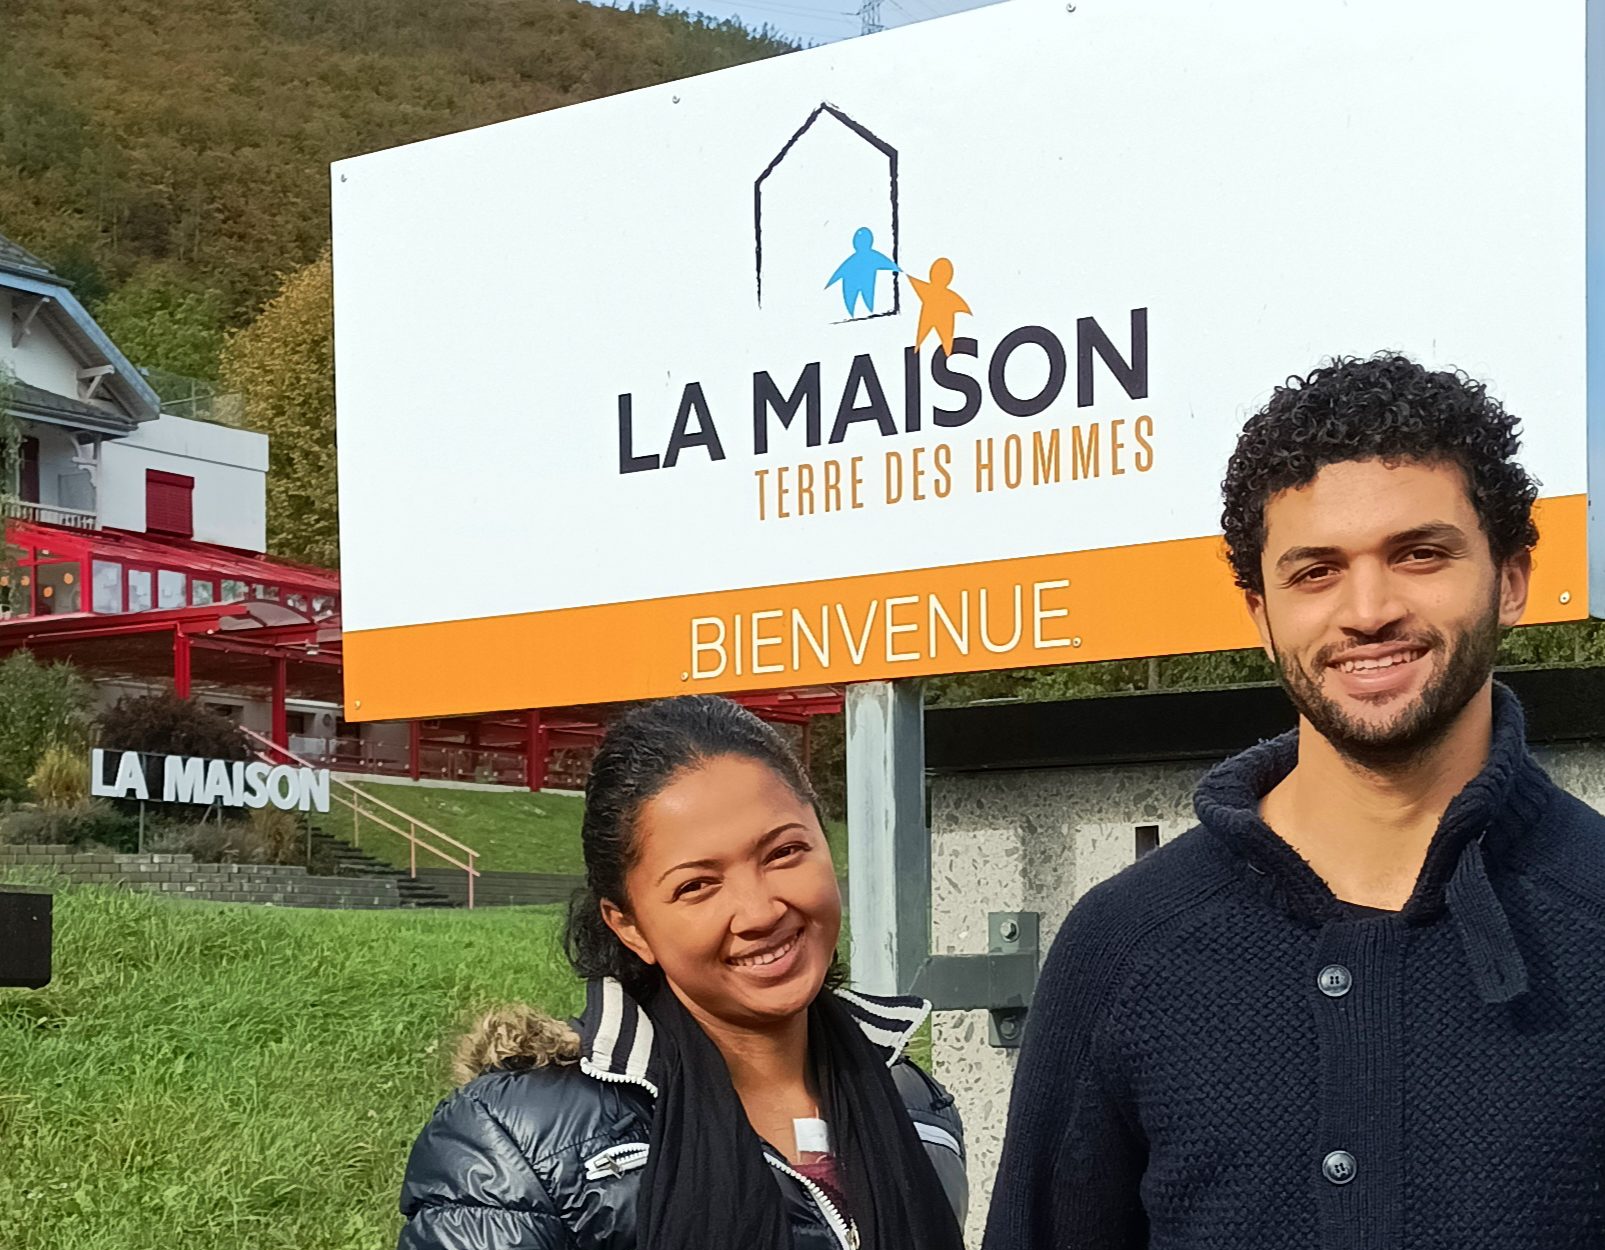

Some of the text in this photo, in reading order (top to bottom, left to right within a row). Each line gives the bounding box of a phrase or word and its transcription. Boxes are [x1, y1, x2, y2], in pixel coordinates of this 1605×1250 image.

[618, 307, 1148, 474] LA MAISON
[754, 415, 1155, 521] TERRE DES HOMMES
[691, 580, 1071, 680] BIENVENUE
[91, 748, 331, 812] LA MAISON
